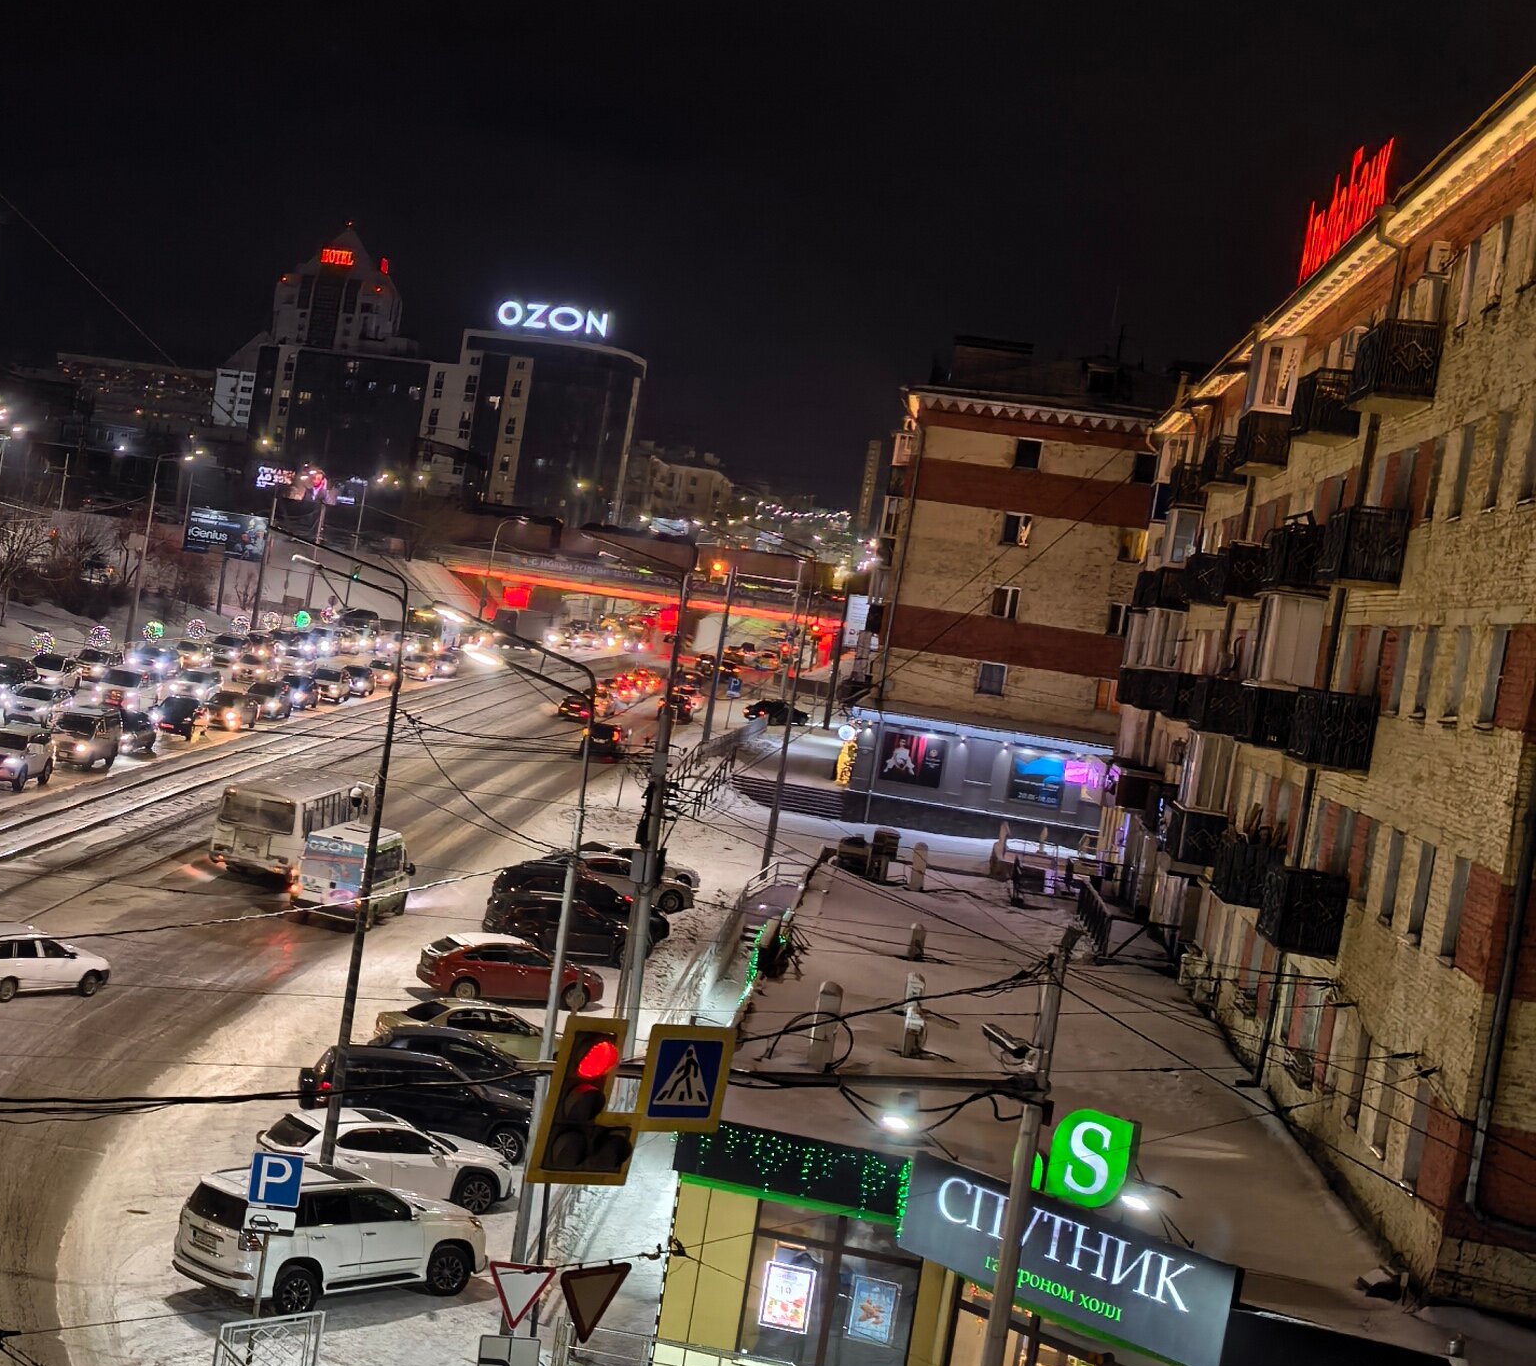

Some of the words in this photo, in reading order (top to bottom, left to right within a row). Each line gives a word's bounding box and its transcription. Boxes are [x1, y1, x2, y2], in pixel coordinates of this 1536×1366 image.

[320, 248, 355, 266] HOTEL
[497, 300, 609, 338] OZON
[187, 526, 229, 542] iGenius
[730, 677, 740, 691] P
[308, 840, 353, 853] OZON
[1064, 1121, 1113, 1195] S
[257, 1155, 293, 1201] P
[984, 1256, 1076, 1303] гароном
[1078, 1293, 1124, 1323] холл
